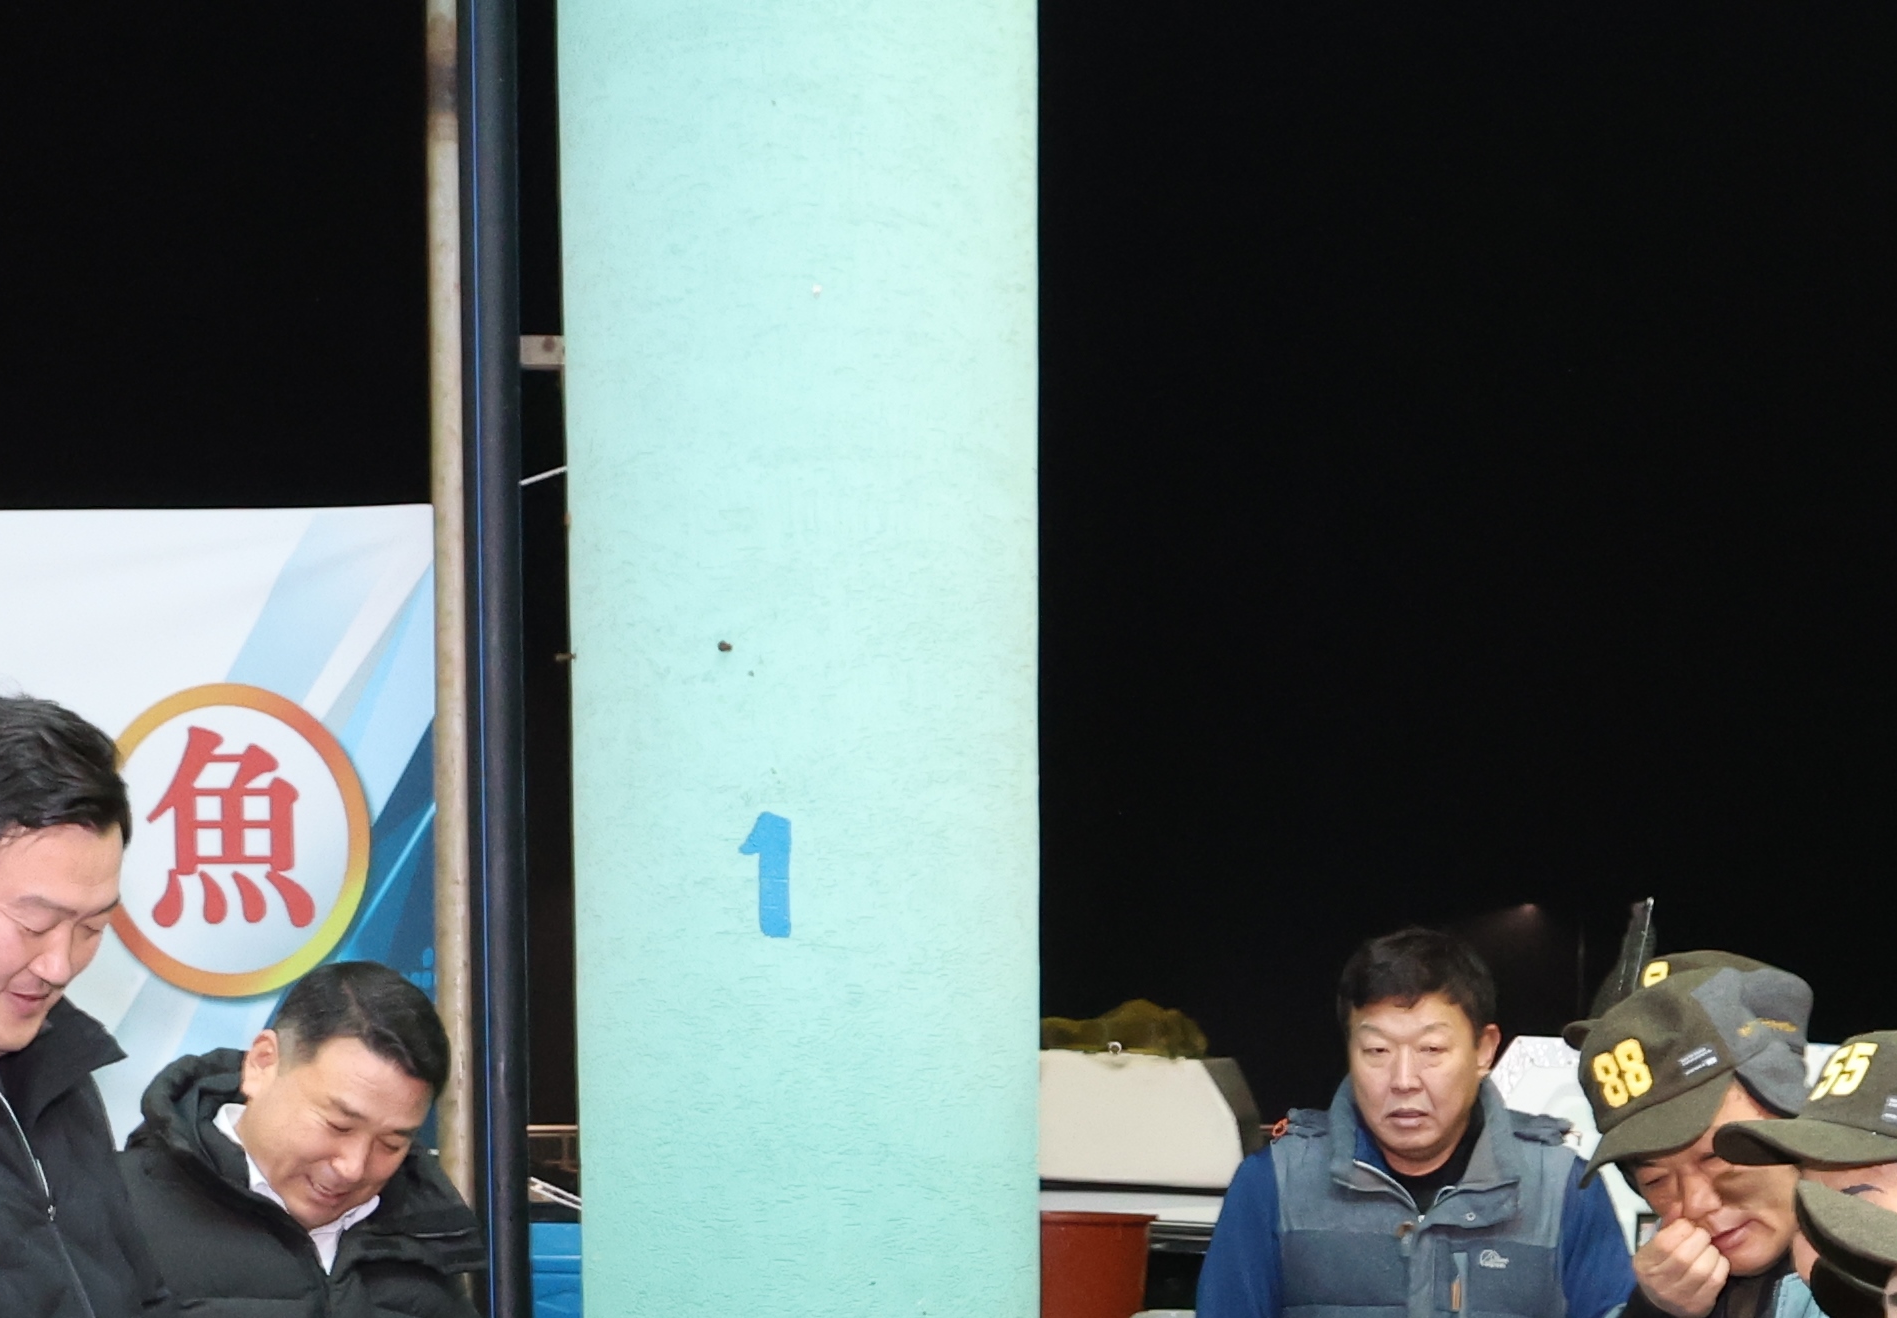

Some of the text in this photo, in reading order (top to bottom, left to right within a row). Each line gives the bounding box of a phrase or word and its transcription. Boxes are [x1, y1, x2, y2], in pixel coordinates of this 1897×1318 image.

[145, 724, 316, 930] 魚
[738, 811, 792, 939] 1
[1592, 1037, 1654, 1109] 88
[1808, 1042, 1879, 1101] 55
